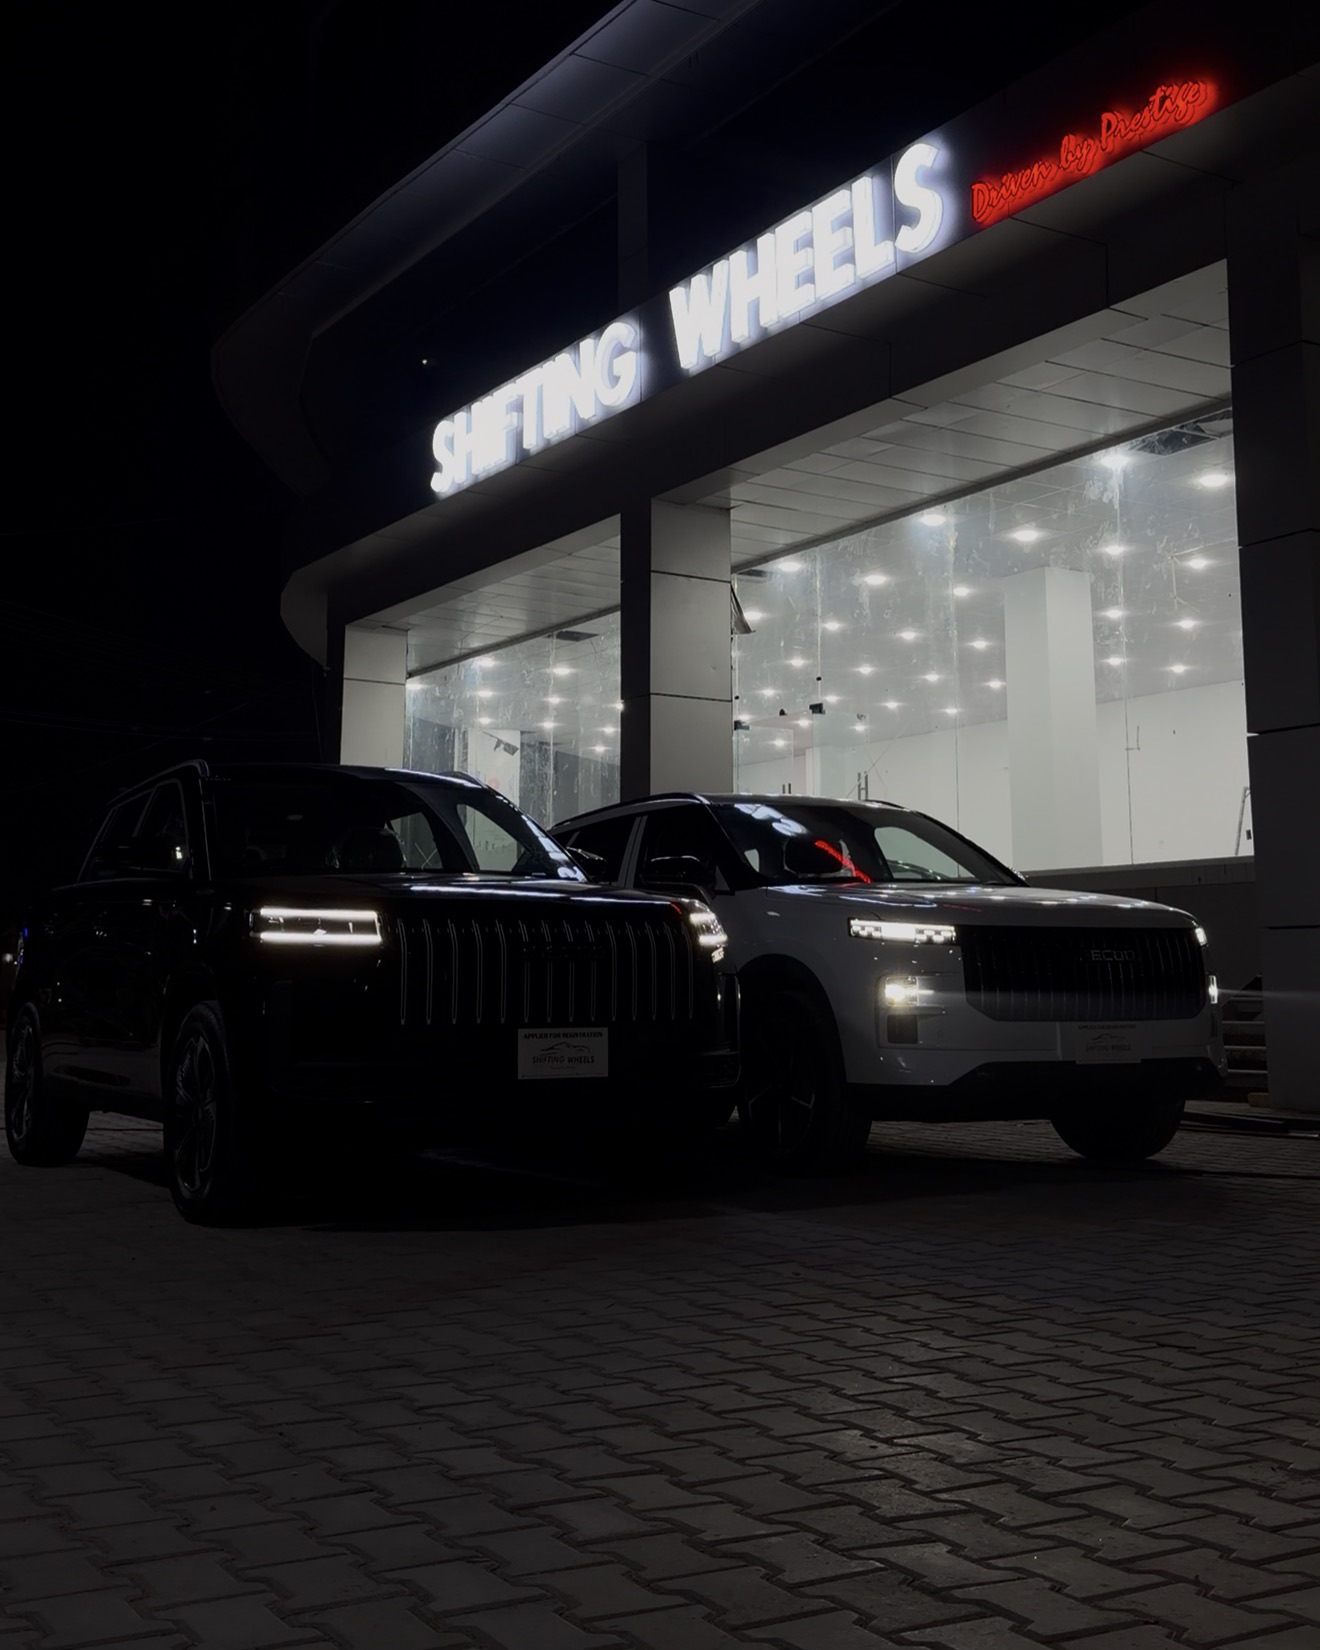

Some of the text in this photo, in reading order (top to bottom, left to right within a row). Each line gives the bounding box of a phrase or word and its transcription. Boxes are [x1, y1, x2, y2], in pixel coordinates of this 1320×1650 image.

[970, 80, 1208, 223] Driven by Prestige
[430, 142, 946, 495] SHIFTING WHEELS
[532, 1055, 595, 1064] SHIFTING WHEELS
